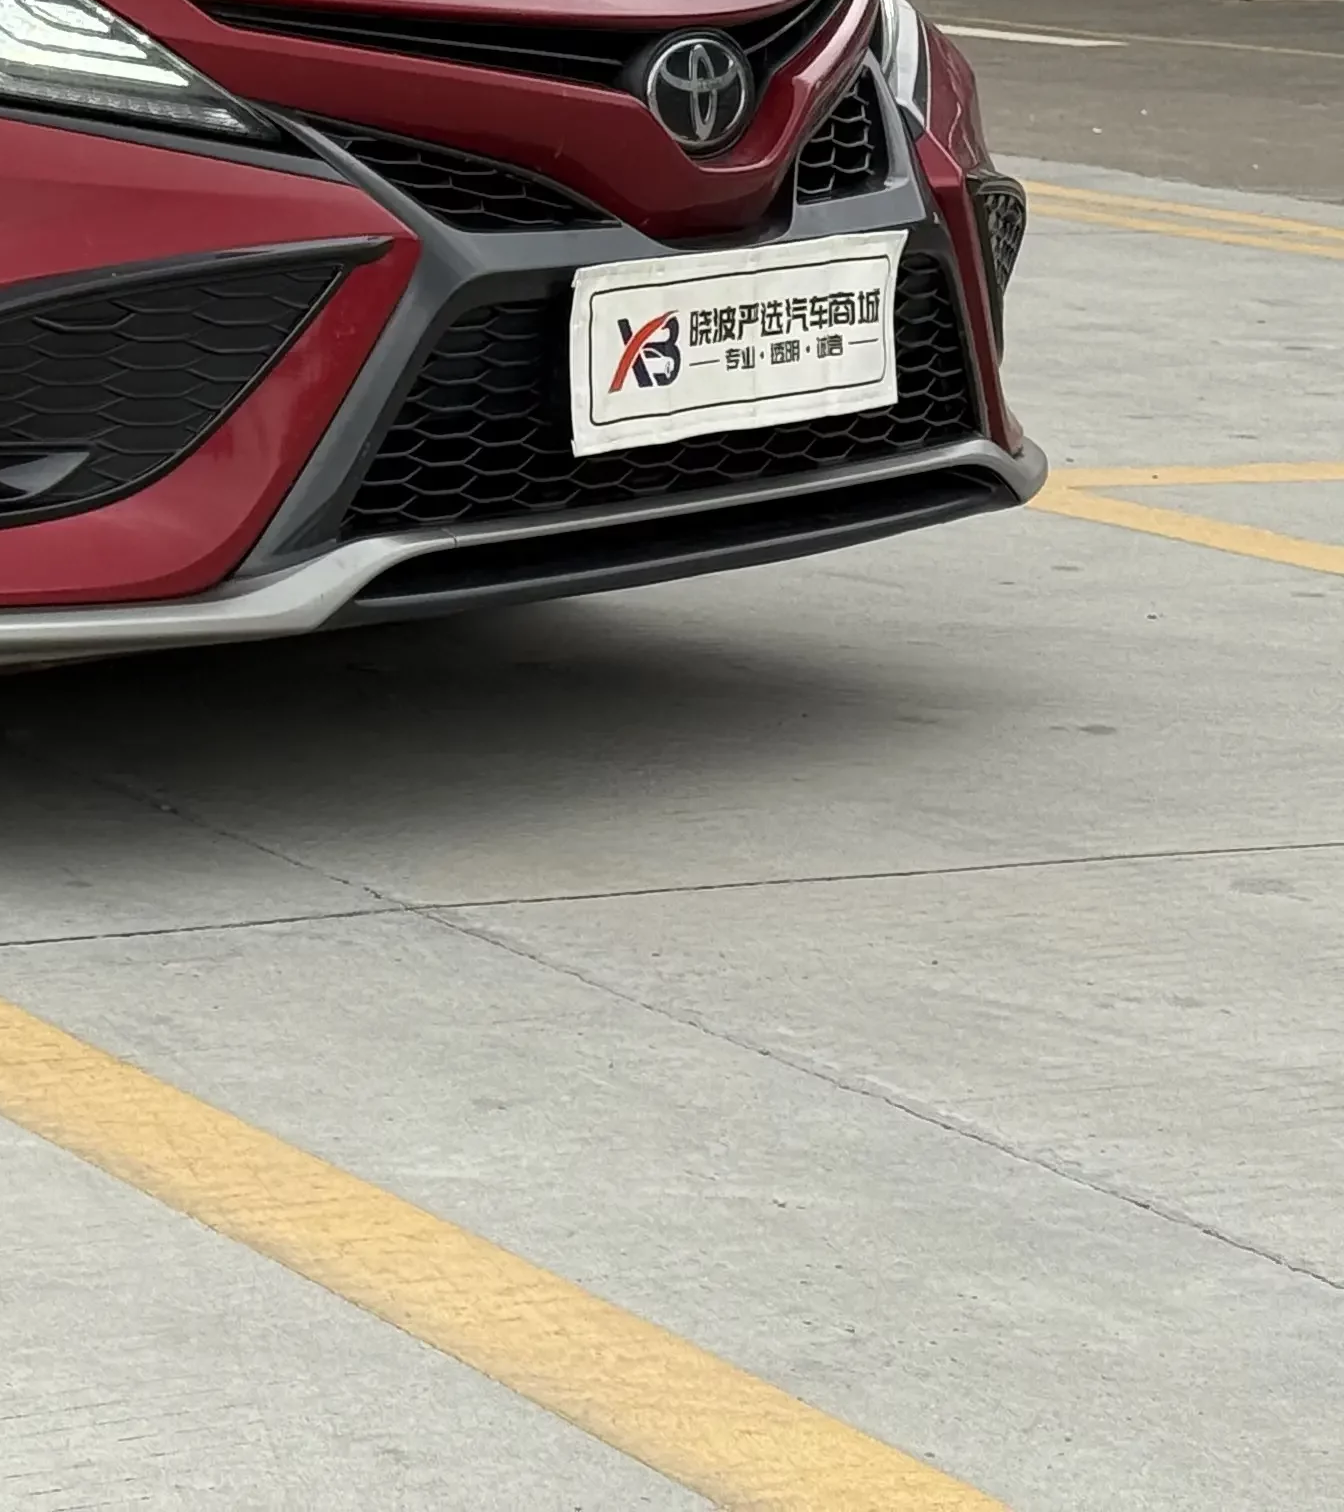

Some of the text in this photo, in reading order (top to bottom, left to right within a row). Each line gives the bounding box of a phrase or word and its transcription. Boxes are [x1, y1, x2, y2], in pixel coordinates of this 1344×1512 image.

[688, 288, 881, 348] 晓波严选汽车商城
